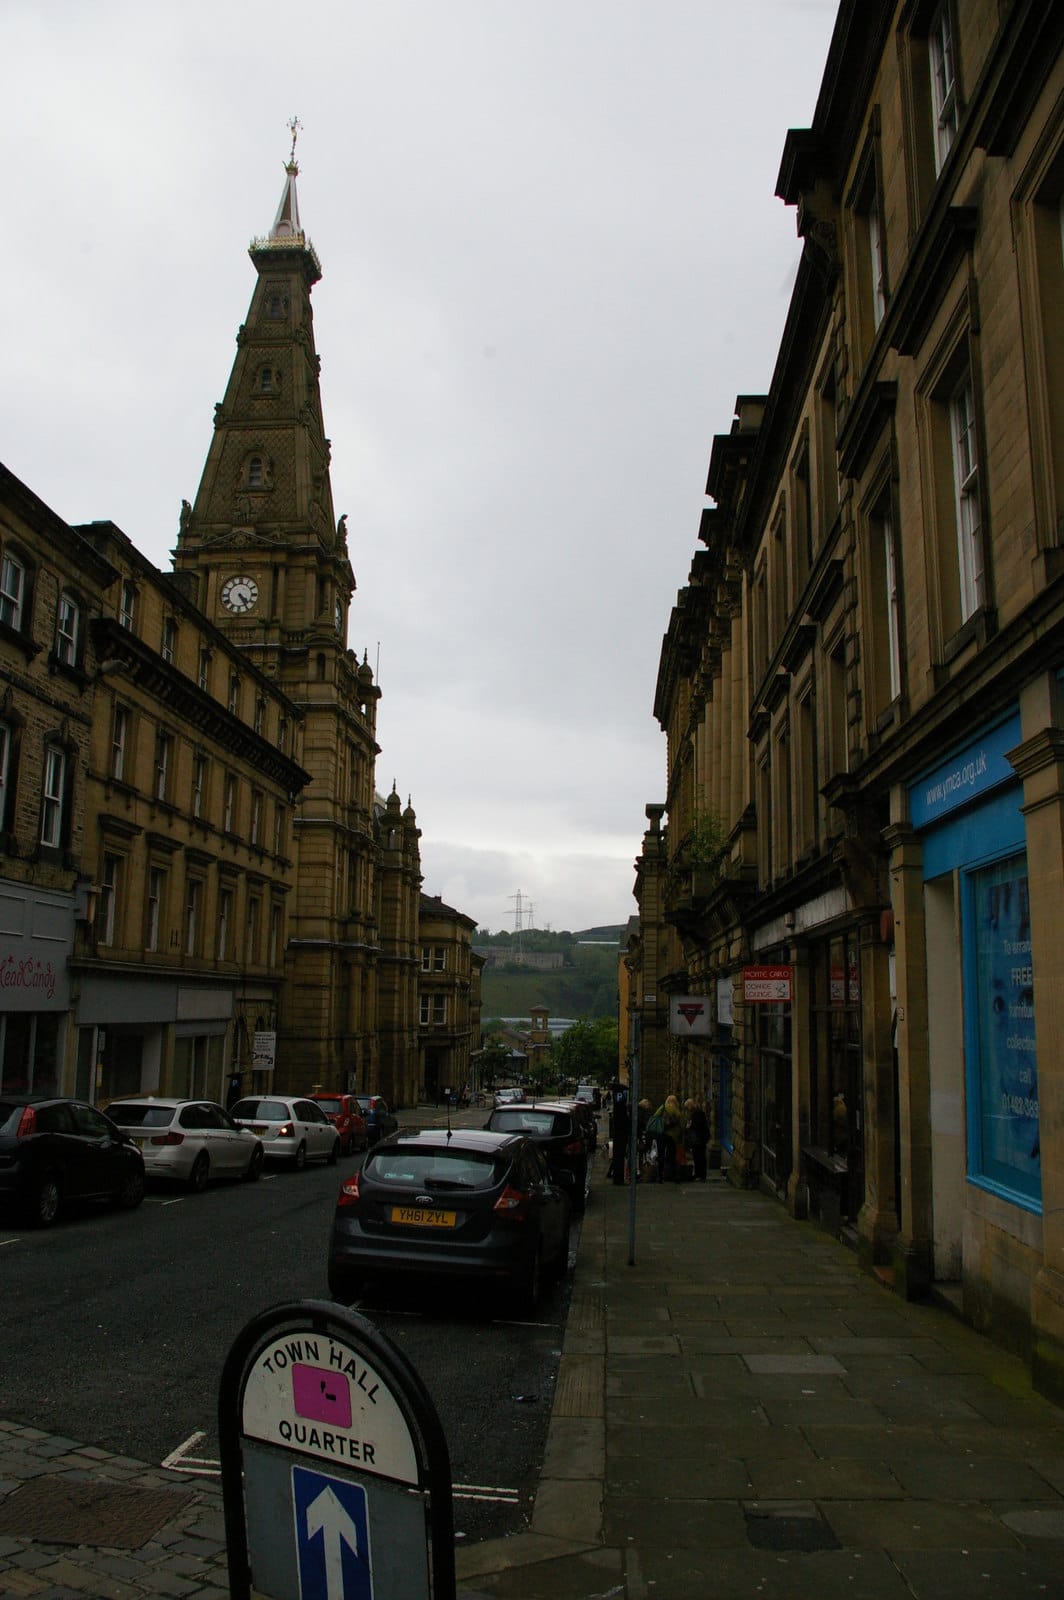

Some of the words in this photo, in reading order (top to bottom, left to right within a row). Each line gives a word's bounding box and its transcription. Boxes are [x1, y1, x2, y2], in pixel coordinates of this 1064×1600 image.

[926, 751, 987, 806] www.ymca.org.uk
[1011, 966, 1032, 987] FREE
[400, 1209, 425, 1222] YH61
[427, 1211, 449, 1224] ZYL
[263, 1341, 319, 1374] TOWN
[330, 1346, 381, 1404] HALL
[279, 1421, 376, 1464] QUARTER
